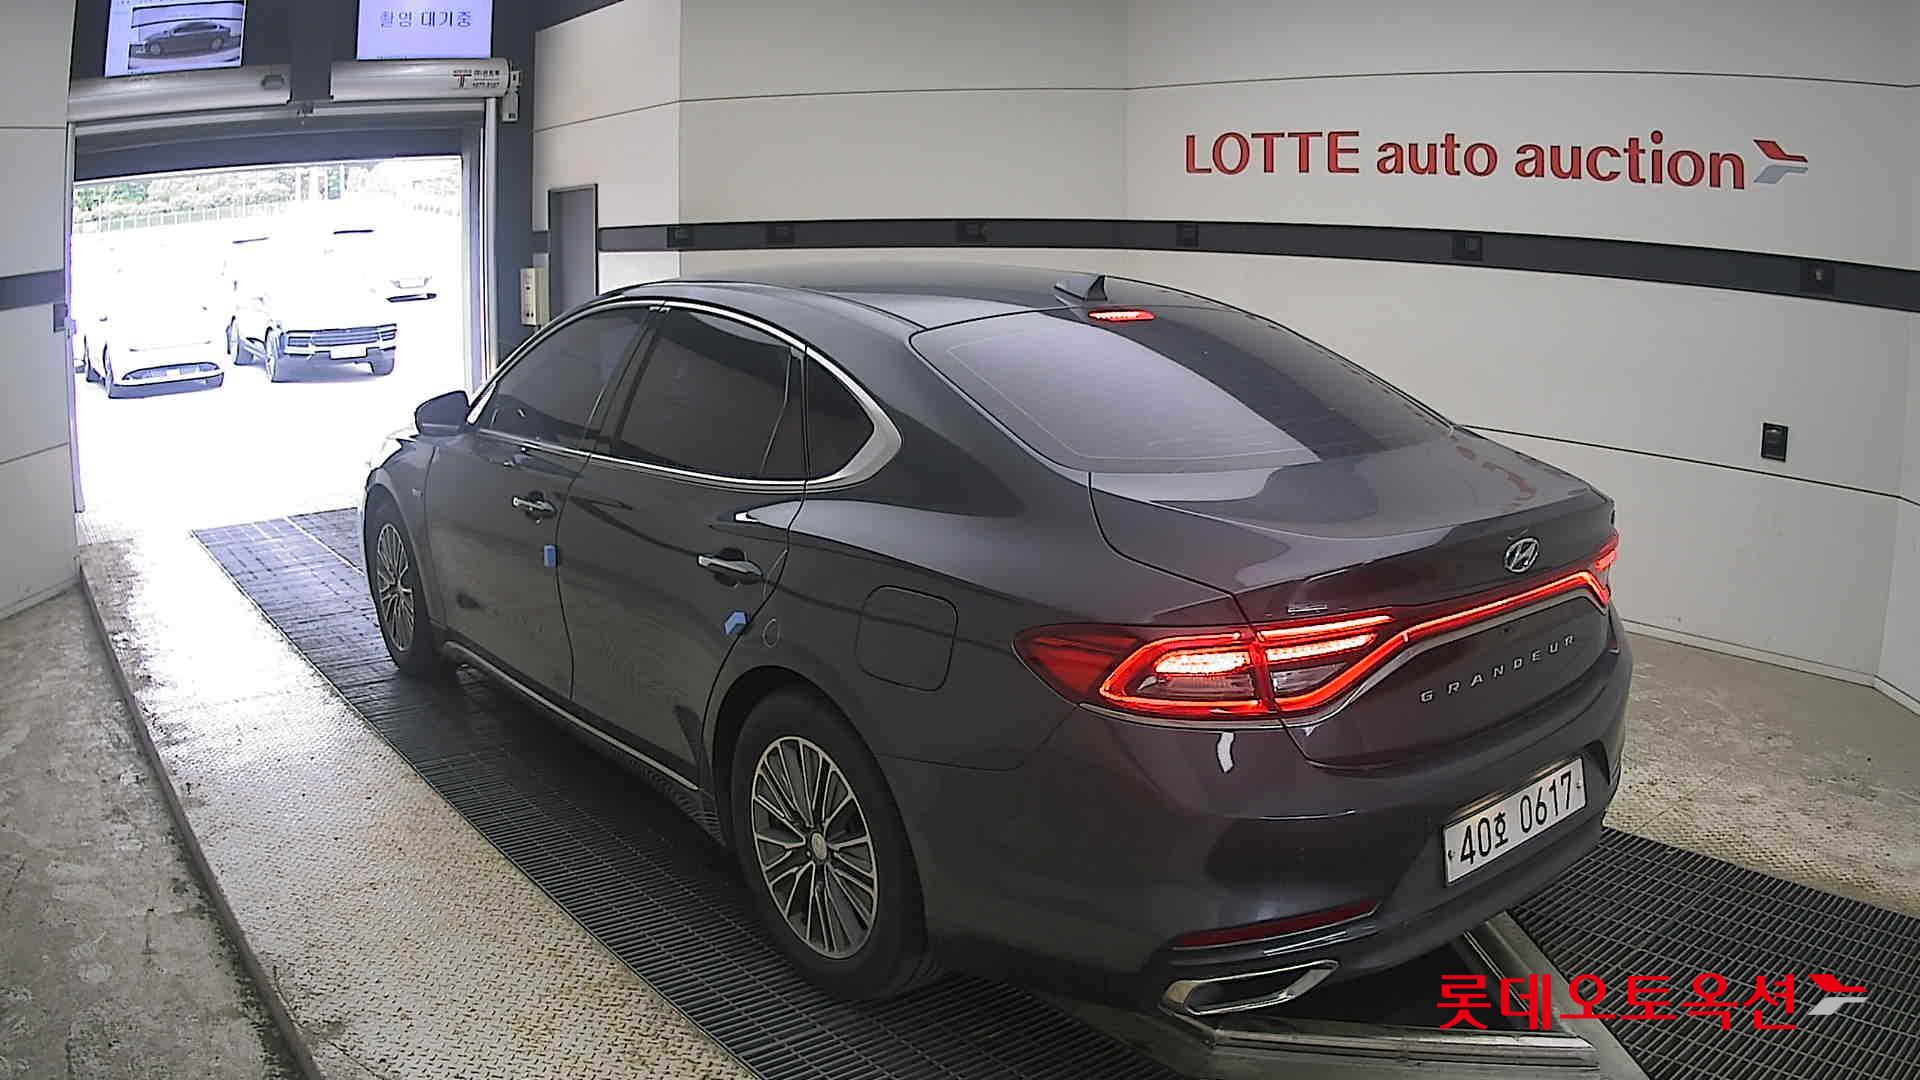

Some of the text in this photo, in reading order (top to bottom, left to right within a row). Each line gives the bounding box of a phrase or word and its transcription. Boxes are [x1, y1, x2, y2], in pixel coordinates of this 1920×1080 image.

[1185, 130, 1747, 190] LOTTE auto auction
[1420, 635, 1576, 703] GRANDEUR
[1460, 770, 1573, 865] 40호 0617
